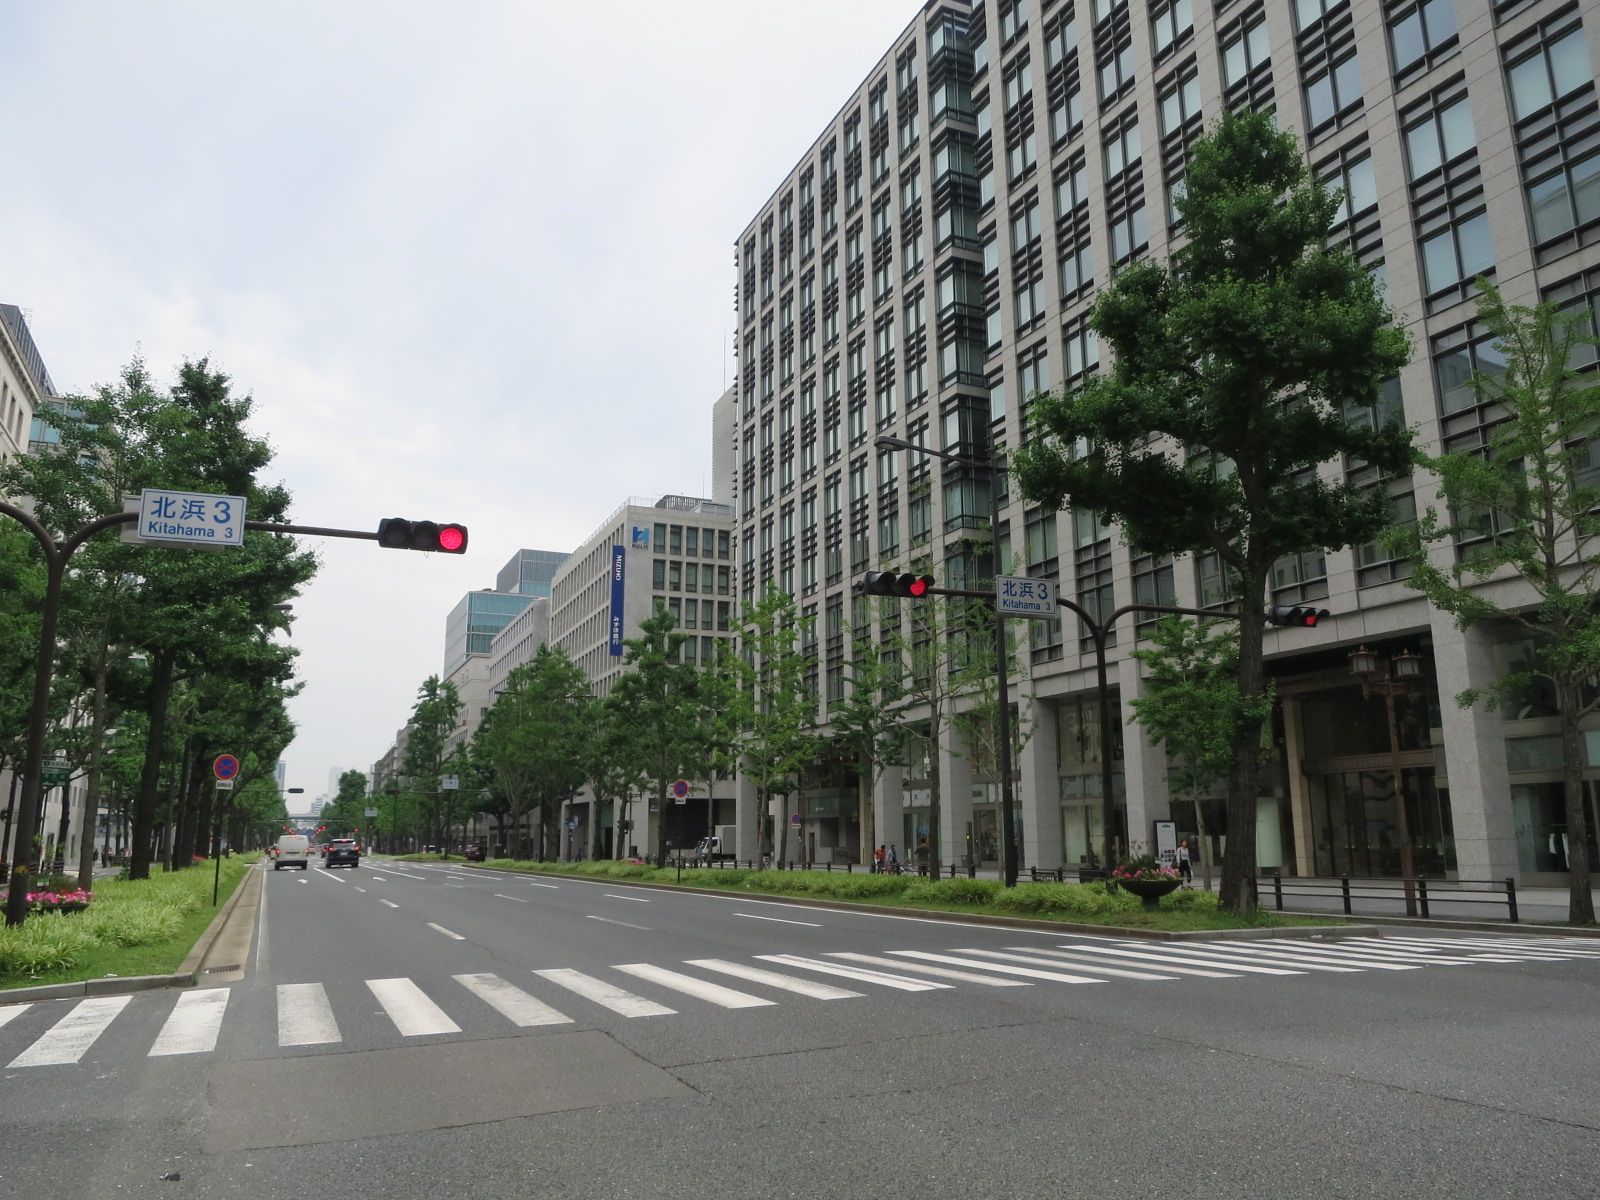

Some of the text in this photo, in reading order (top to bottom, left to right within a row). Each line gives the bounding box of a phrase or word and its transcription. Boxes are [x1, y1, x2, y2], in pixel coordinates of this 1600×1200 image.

[150, 496, 231, 524] 北浜3
[148, 521, 233, 539] Kitahama 3
[615, 554, 623, 581] MIZUHO
[1002, 580, 1048, 600] 北浜3
[1002, 599, 1051, 611] Kitahama 3
